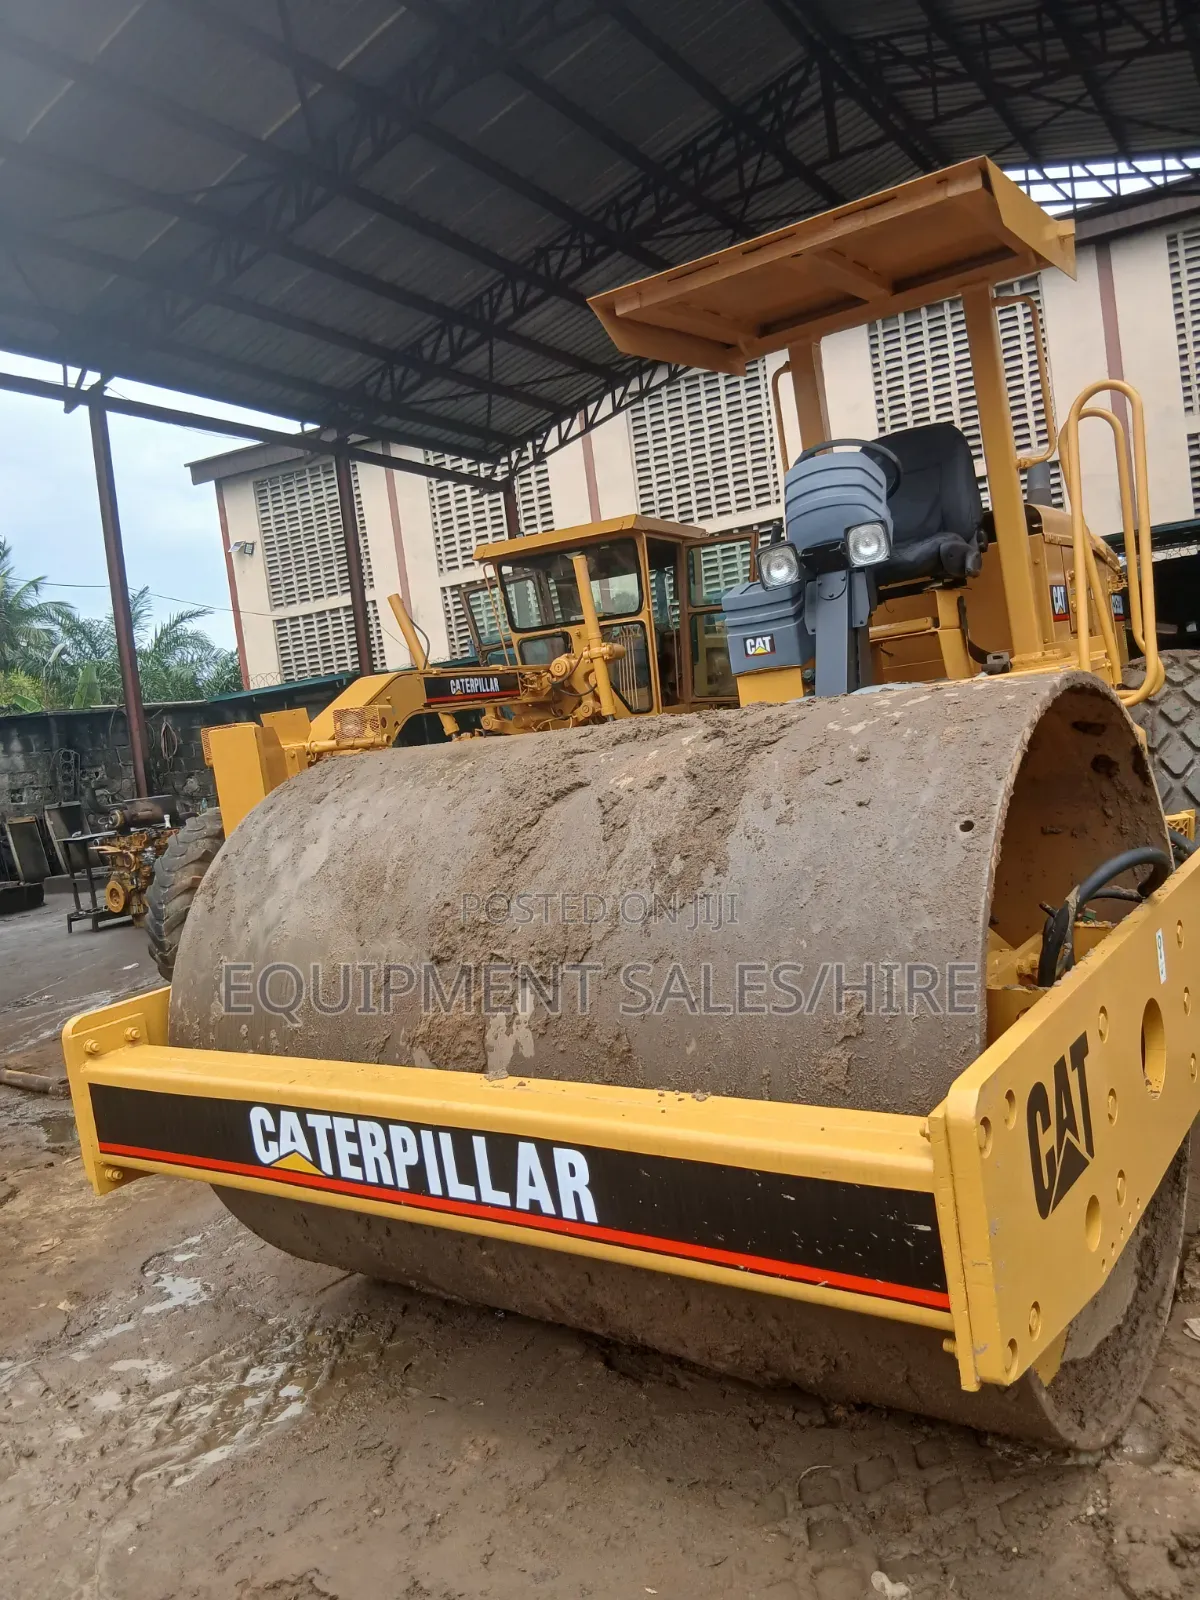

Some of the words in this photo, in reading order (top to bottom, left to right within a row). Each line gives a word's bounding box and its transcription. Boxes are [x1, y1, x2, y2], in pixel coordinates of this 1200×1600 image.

[1052, 586, 1067, 615] CAT
[746, 636, 771, 655] CAT
[449, 677, 500, 695] CATERPILLAR
[1026, 1030, 1095, 1220] CAT
[249, 1105, 599, 1224] CATERPILLAR
